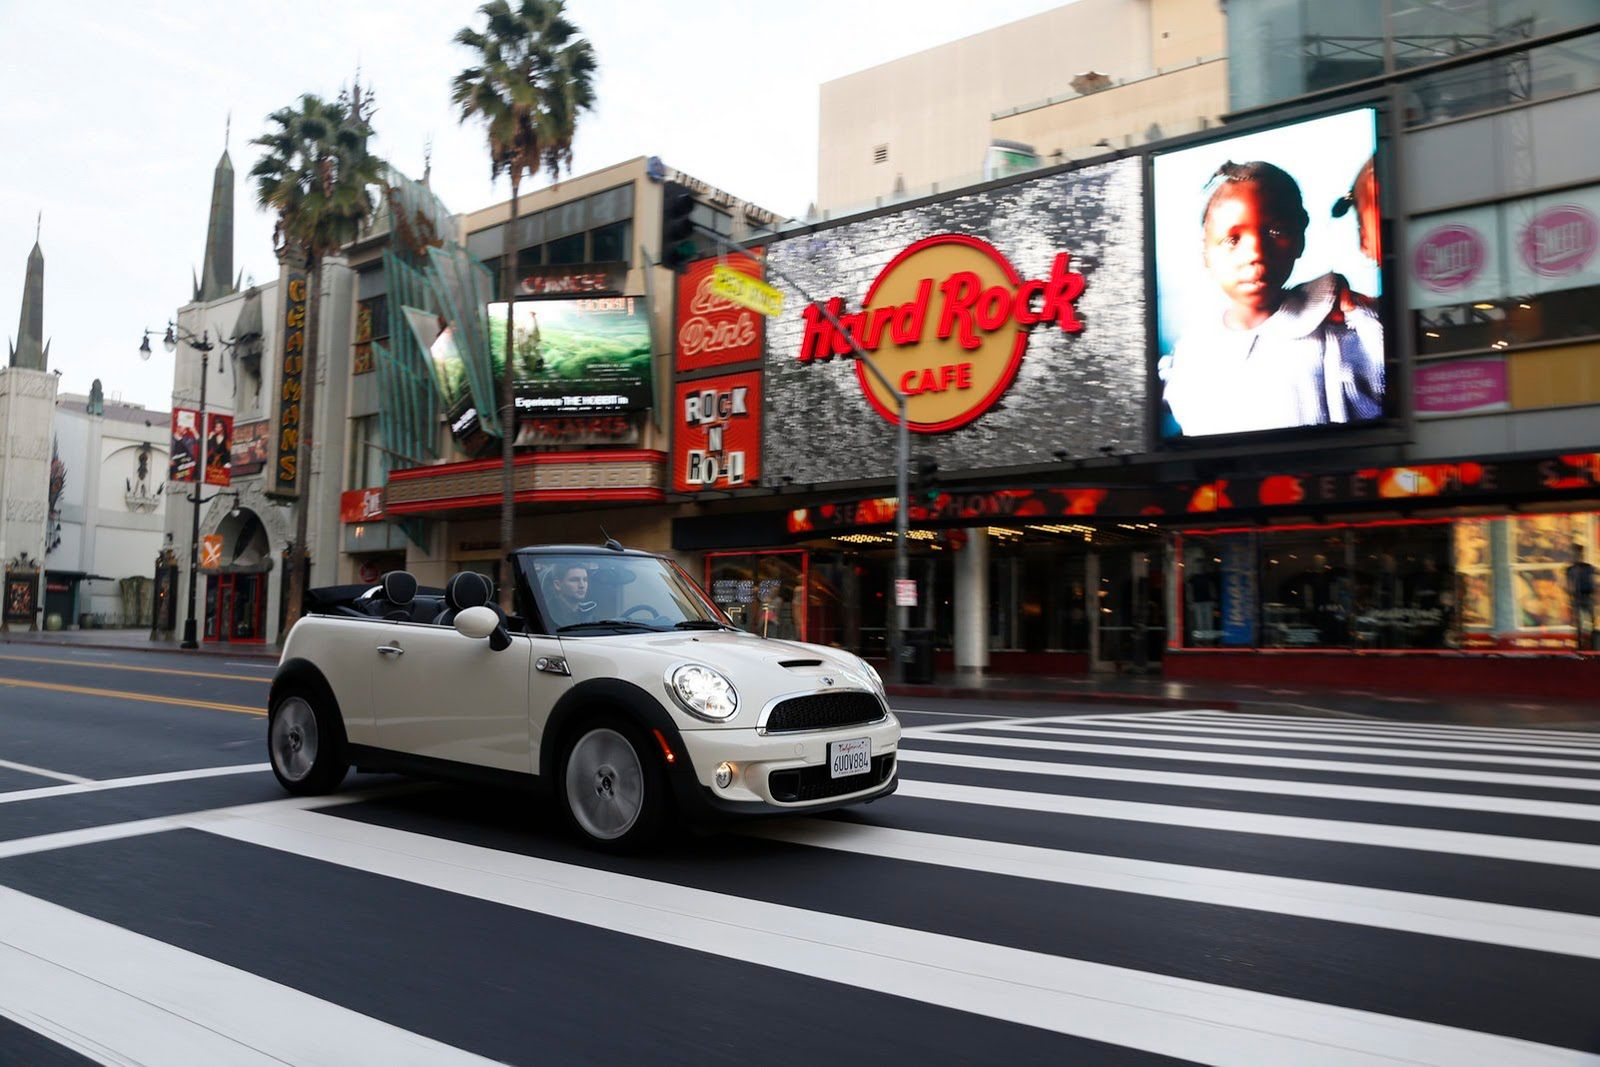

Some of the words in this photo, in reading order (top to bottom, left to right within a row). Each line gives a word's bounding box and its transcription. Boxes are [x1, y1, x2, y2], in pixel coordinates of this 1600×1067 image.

[797, 278, 934, 361] Hard
[937, 251, 1086, 351] Rock
[901, 363, 973, 395] CAFE
[684, 388, 749, 427] ROCK
[686, 450, 746, 485] ROLL
